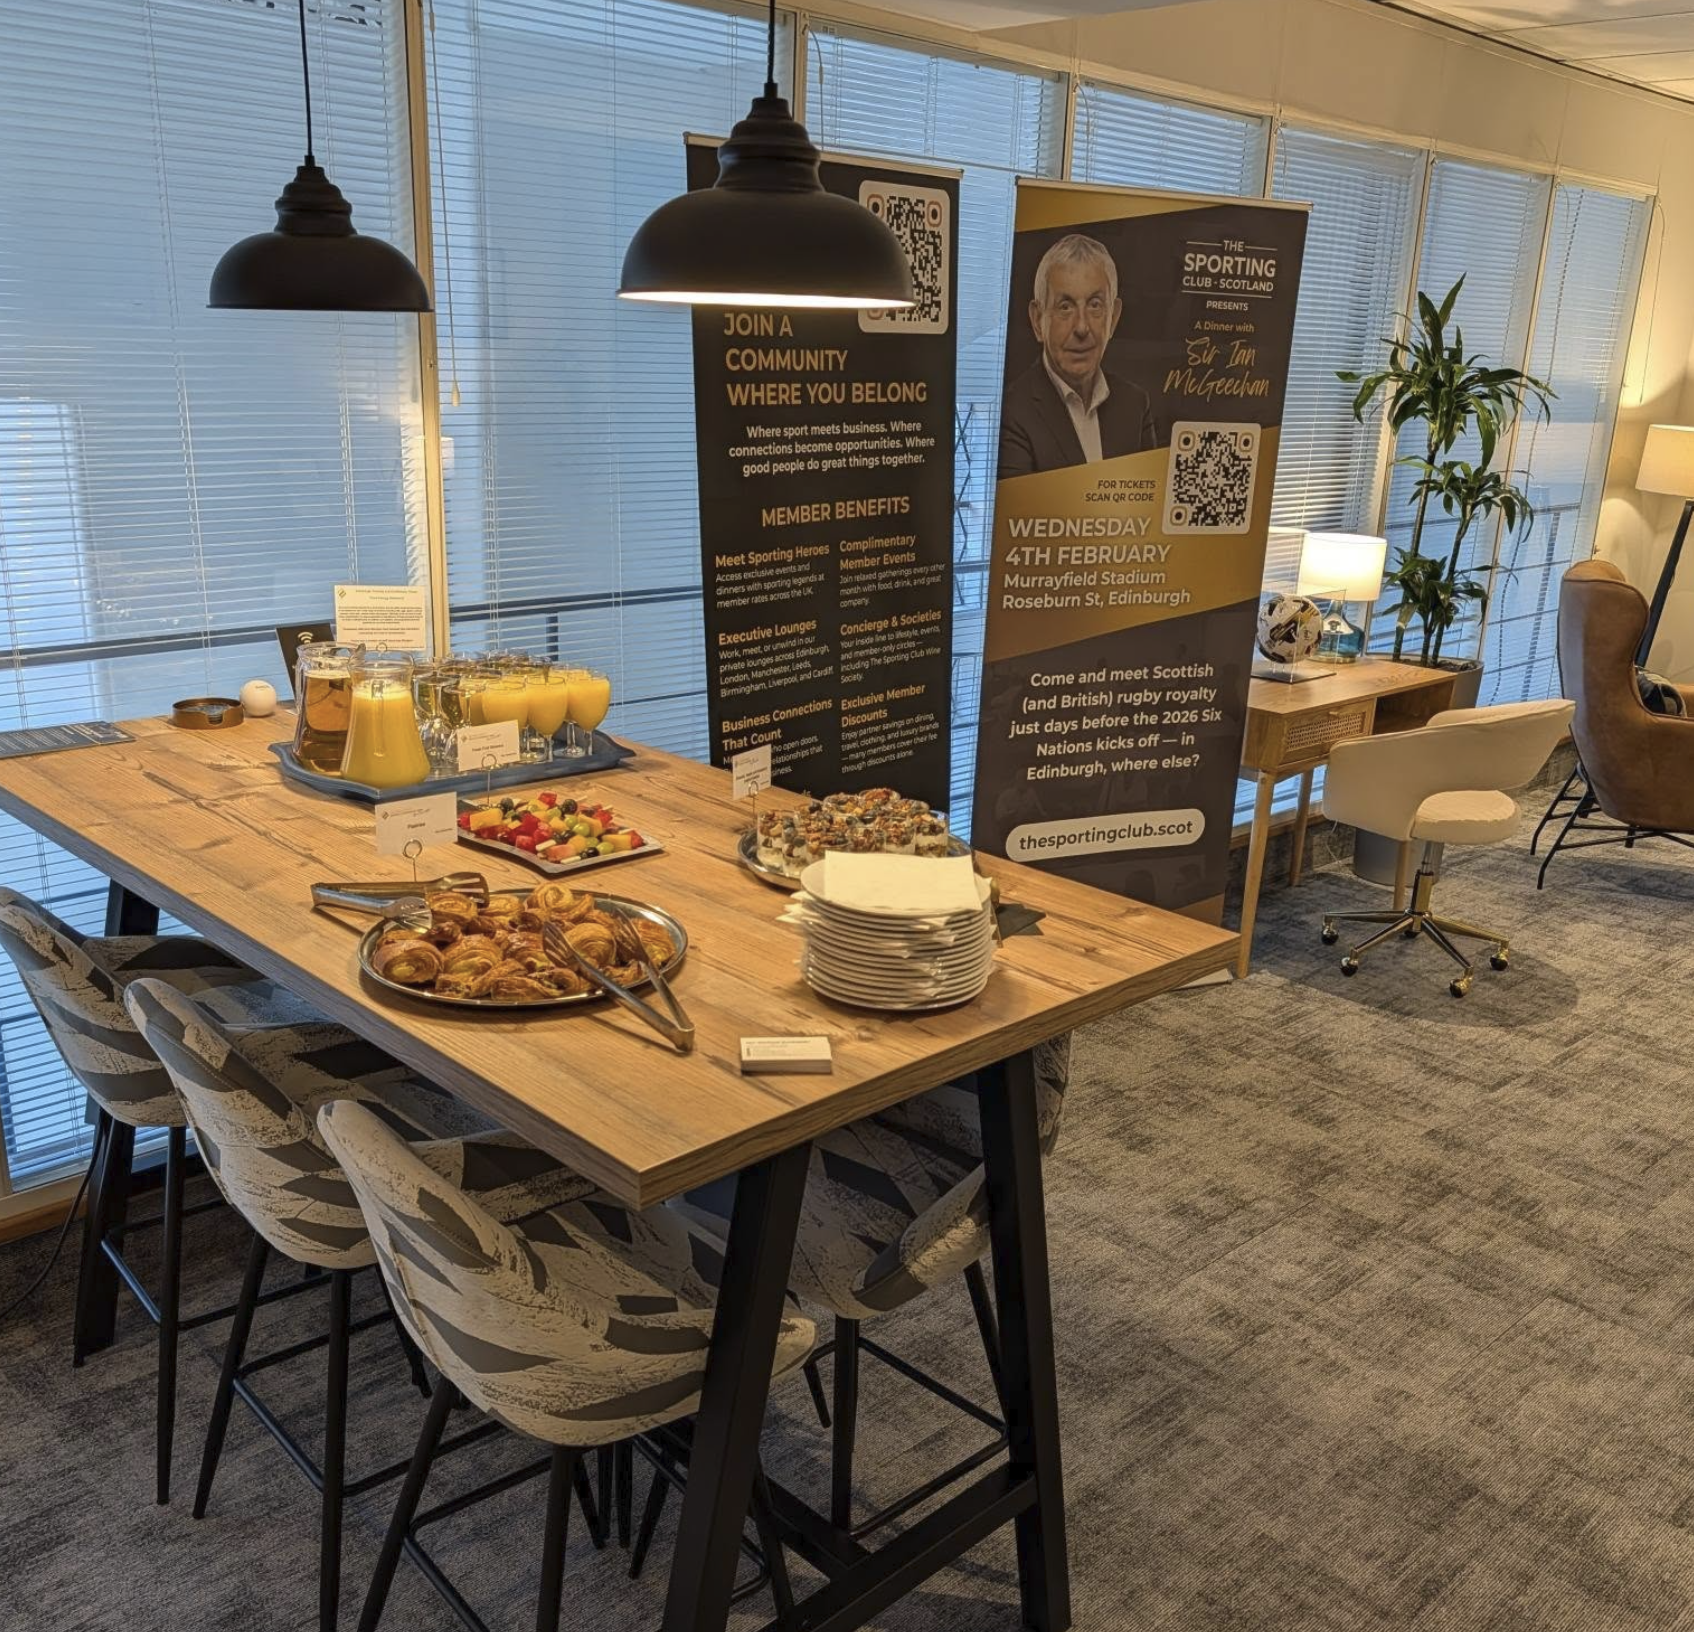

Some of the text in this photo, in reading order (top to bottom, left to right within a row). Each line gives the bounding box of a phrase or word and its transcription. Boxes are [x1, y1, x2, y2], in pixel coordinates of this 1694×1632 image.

[1223, 240, 1244, 252] THE
[1184, 253, 1275, 277] SPORTING
[1183, 276, 1212, 287] CLUB
[1219, 278, 1273, 291] SCOTLAND
[1206, 300, 1248, 311] PRESENTS
[724, 313, 793, 336] JOIN A
[1194, 321, 1254, 332] A Dinner with
[726, 348, 847, 371] COMMUNITY
[1185, 336, 1255, 368] Sir Ian
[727, 382, 926, 405] WHERE YOU BELONG
[1163, 368, 1269, 402] McGeechan
[746, 420, 921, 439] Where sport meets business. Where
[729, 436, 935, 457] connections become opportunities. Where
[743, 452, 925, 477] good people do great things together.
[1097, 480, 1156, 489] FOR TICKETS
[1085, 492, 1154, 503] SCAN QR CODE
[762, 496, 909, 527] MEMBER BENEFITS
[1009, 516, 1151, 537] WEDNESDAY
[839, 535, 916, 552] Complimentary
[1006, 544, 1171, 565] 4TH FEBRUARY
[716, 545, 829, 567] Meet Sporting Heroes
[840, 552, 915, 570] Member Events
[715, 562, 810, 582] Access exclusive events and
[1004, 570, 1165, 590] Murrayfield Stadium
[716, 585, 745, 595] dinners
[746, 582, 762, 591] with
[763, 579, 791, 590] sporting
[792, 574, 817, 586] legends
[717, 597, 750, 607] member
[751, 595, 768, 603] rates
[769, 591, 790, 601] across
[1003, 589, 1190, 608] Roseburn St, Edinburgh
[719, 620, 817, 645] Executive Lounges
[840, 609, 941, 635] Concierge & Societies
[719, 662, 745, 673] private
[747, 656, 774, 667] lounges
[774, 652, 795, 662] across
[1031, 663, 1213, 686] Come and meet Scottish
[841, 685, 925, 710] Exclusive Member
[1023, 687, 1216, 714] (and British) rugby royalty
[722, 699, 832, 733] Business Connections
[841, 709, 887, 727] Discounts
[1008, 708, 1222, 738] just days before the 2026 Six
[722, 728, 781, 751] That Count
[1037, 740, 1092, 756] Nations
[1096, 736, 1134, 750] kicks
[1138, 733, 1160, 747] off
[1181, 732, 1194, 745] in
[1027, 754, 1199, 780] Edinburgh, where else?
[1019, 821, 1193, 850] thesportingclub.scot
